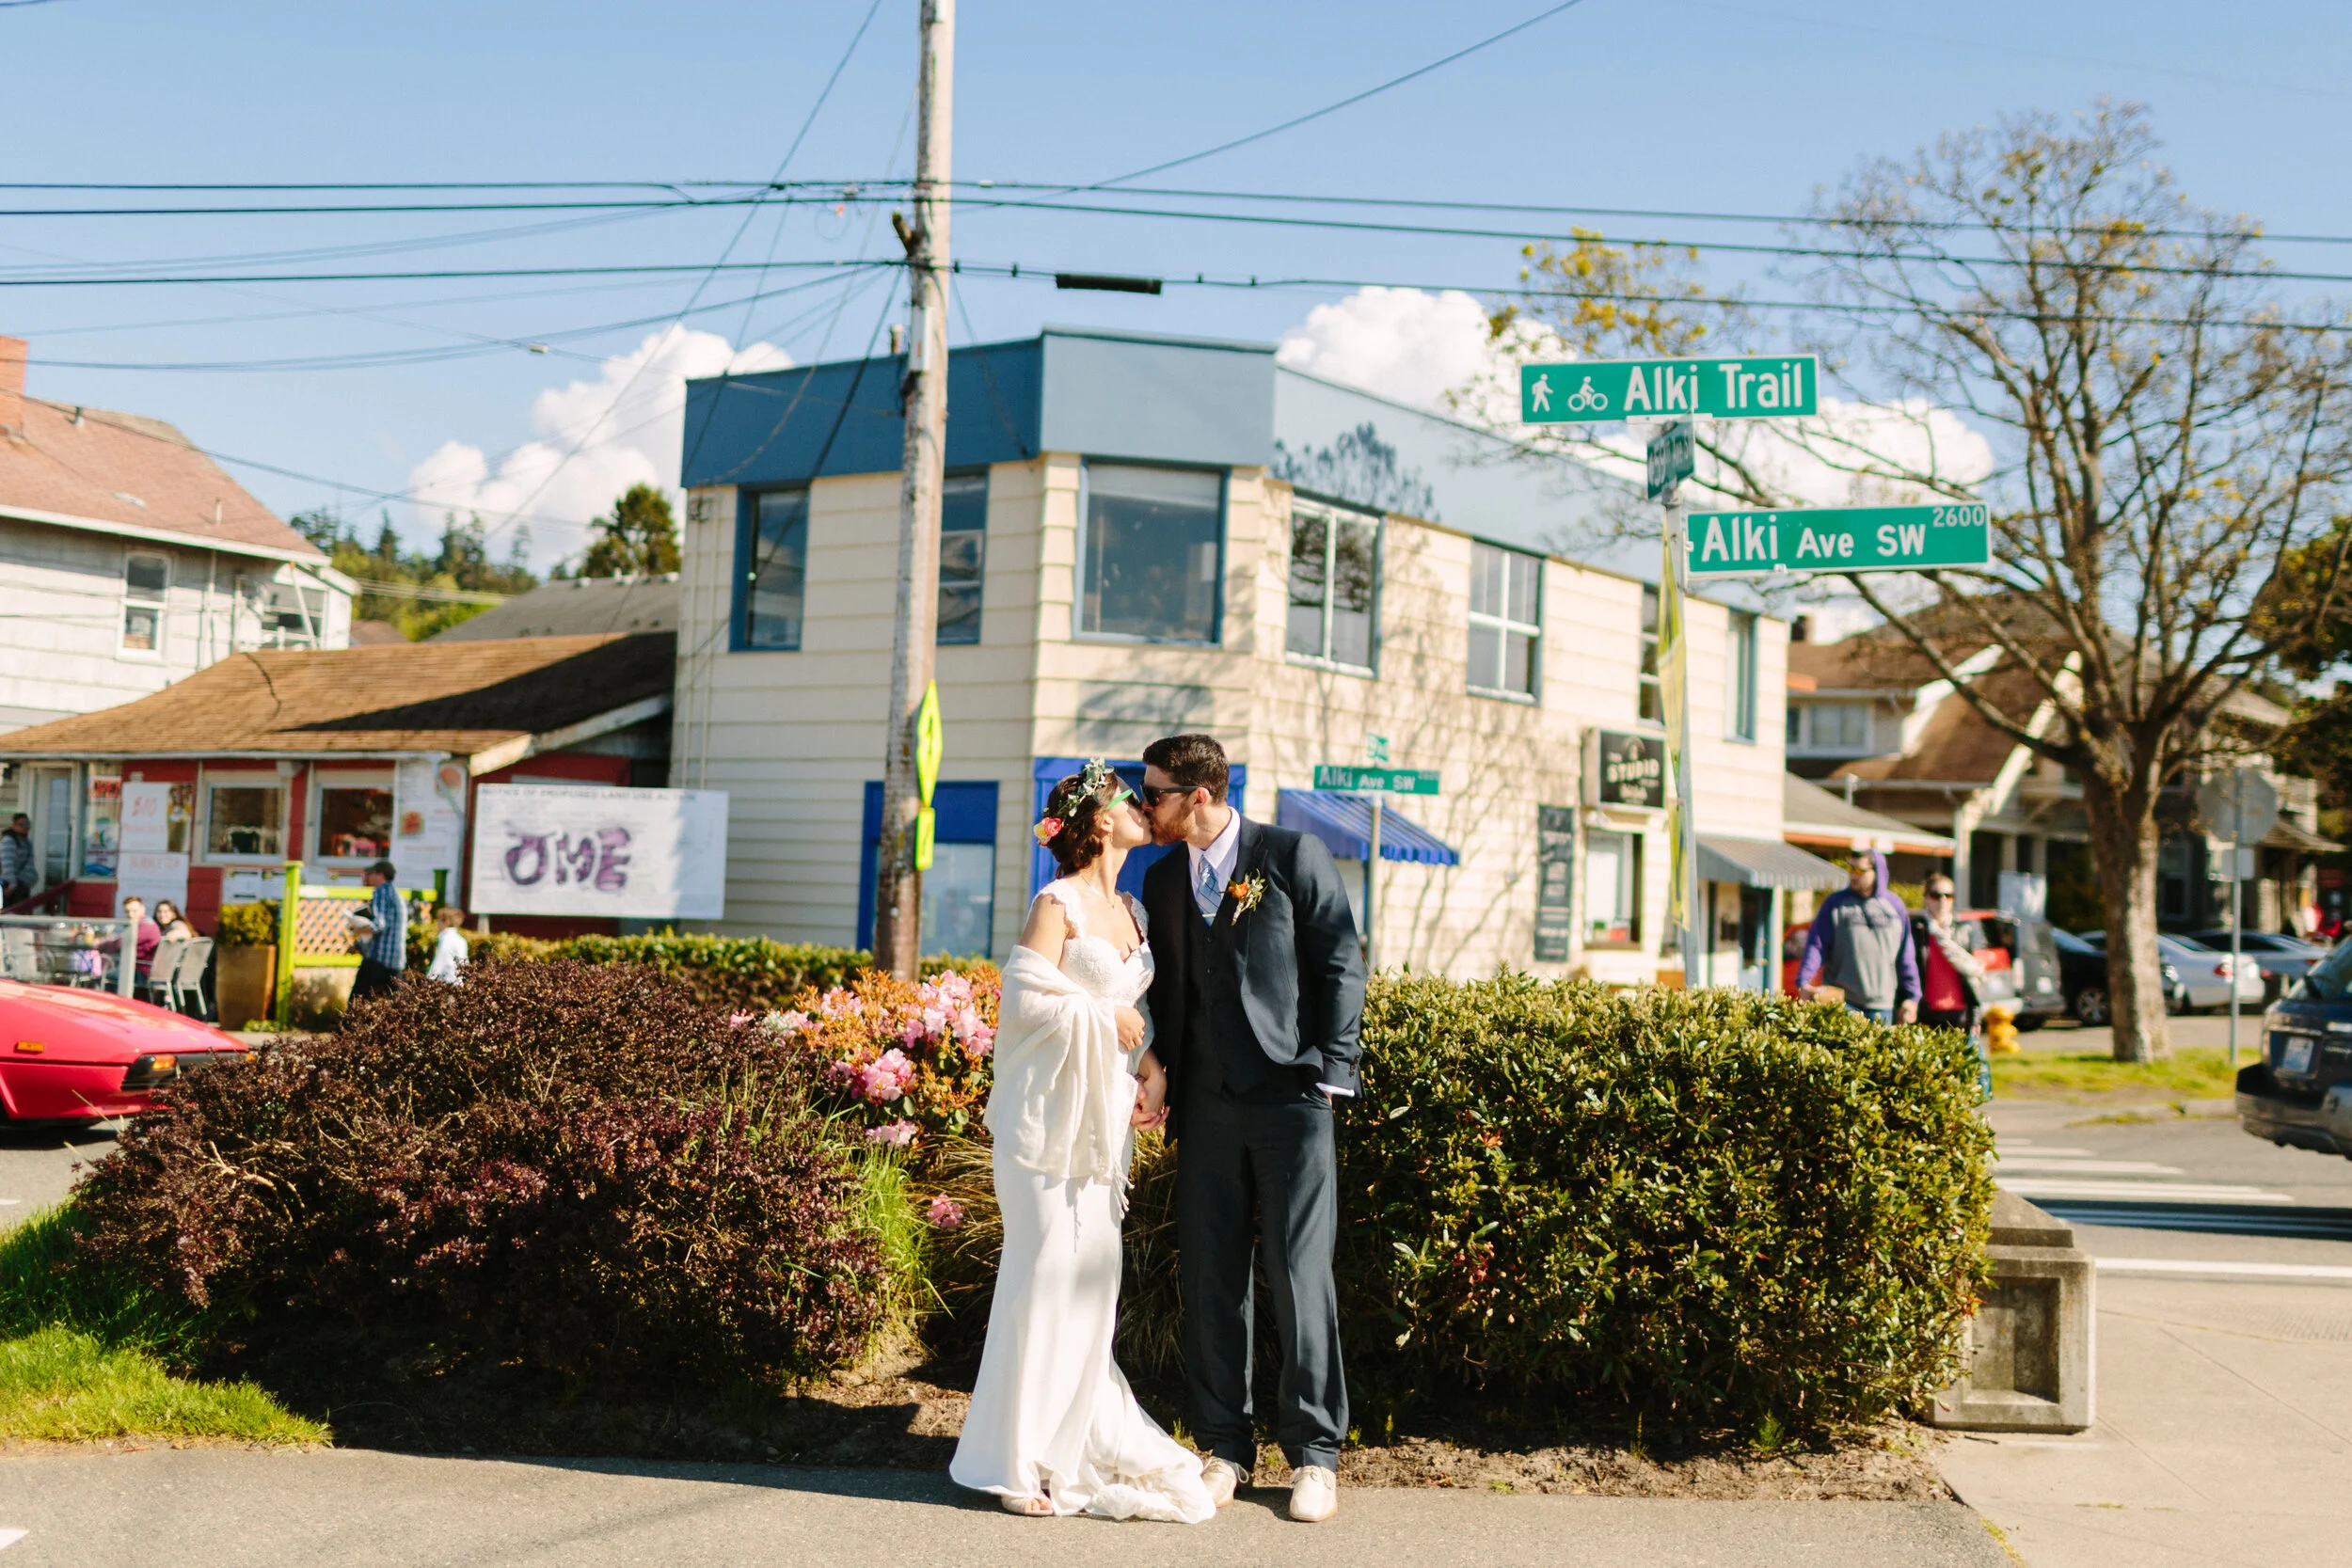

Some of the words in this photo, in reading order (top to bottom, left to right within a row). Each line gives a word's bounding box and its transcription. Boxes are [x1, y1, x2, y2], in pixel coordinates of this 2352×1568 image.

[1624, 364, 1699, 411] Alki
[1718, 361, 1803, 409] Trail
[1701, 515, 1778, 562] Alki
[1796, 527, 1854, 558] Ave
[1877, 523, 1926, 557] SW
[1932, 506, 1985, 528] 2600
[1319, 766, 1353, 787] Alki
[1358, 774, 1385, 790] Ave
[1392, 774, 1416, 791] SW
[1607, 758, 1660, 784] STUDIO
